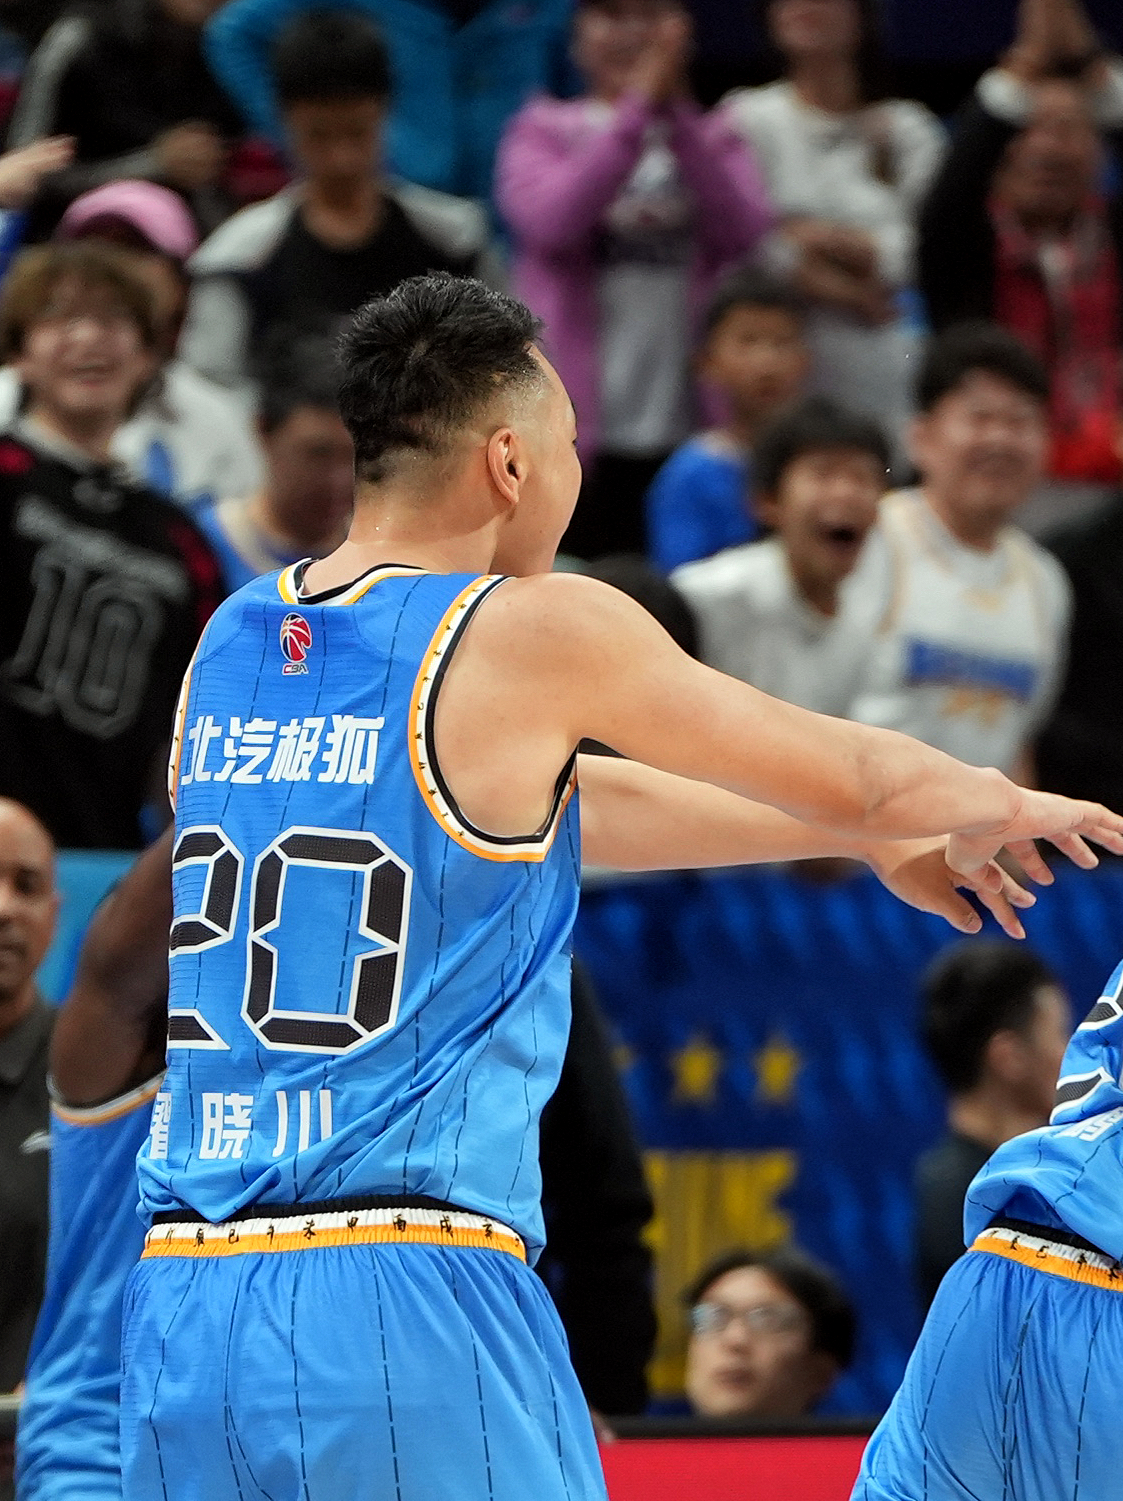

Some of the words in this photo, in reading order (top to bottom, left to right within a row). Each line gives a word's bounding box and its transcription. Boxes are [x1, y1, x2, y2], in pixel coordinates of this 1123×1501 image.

[180, 713, 386, 787] 北汽极狐
[167, 824, 415, 1056] 20
